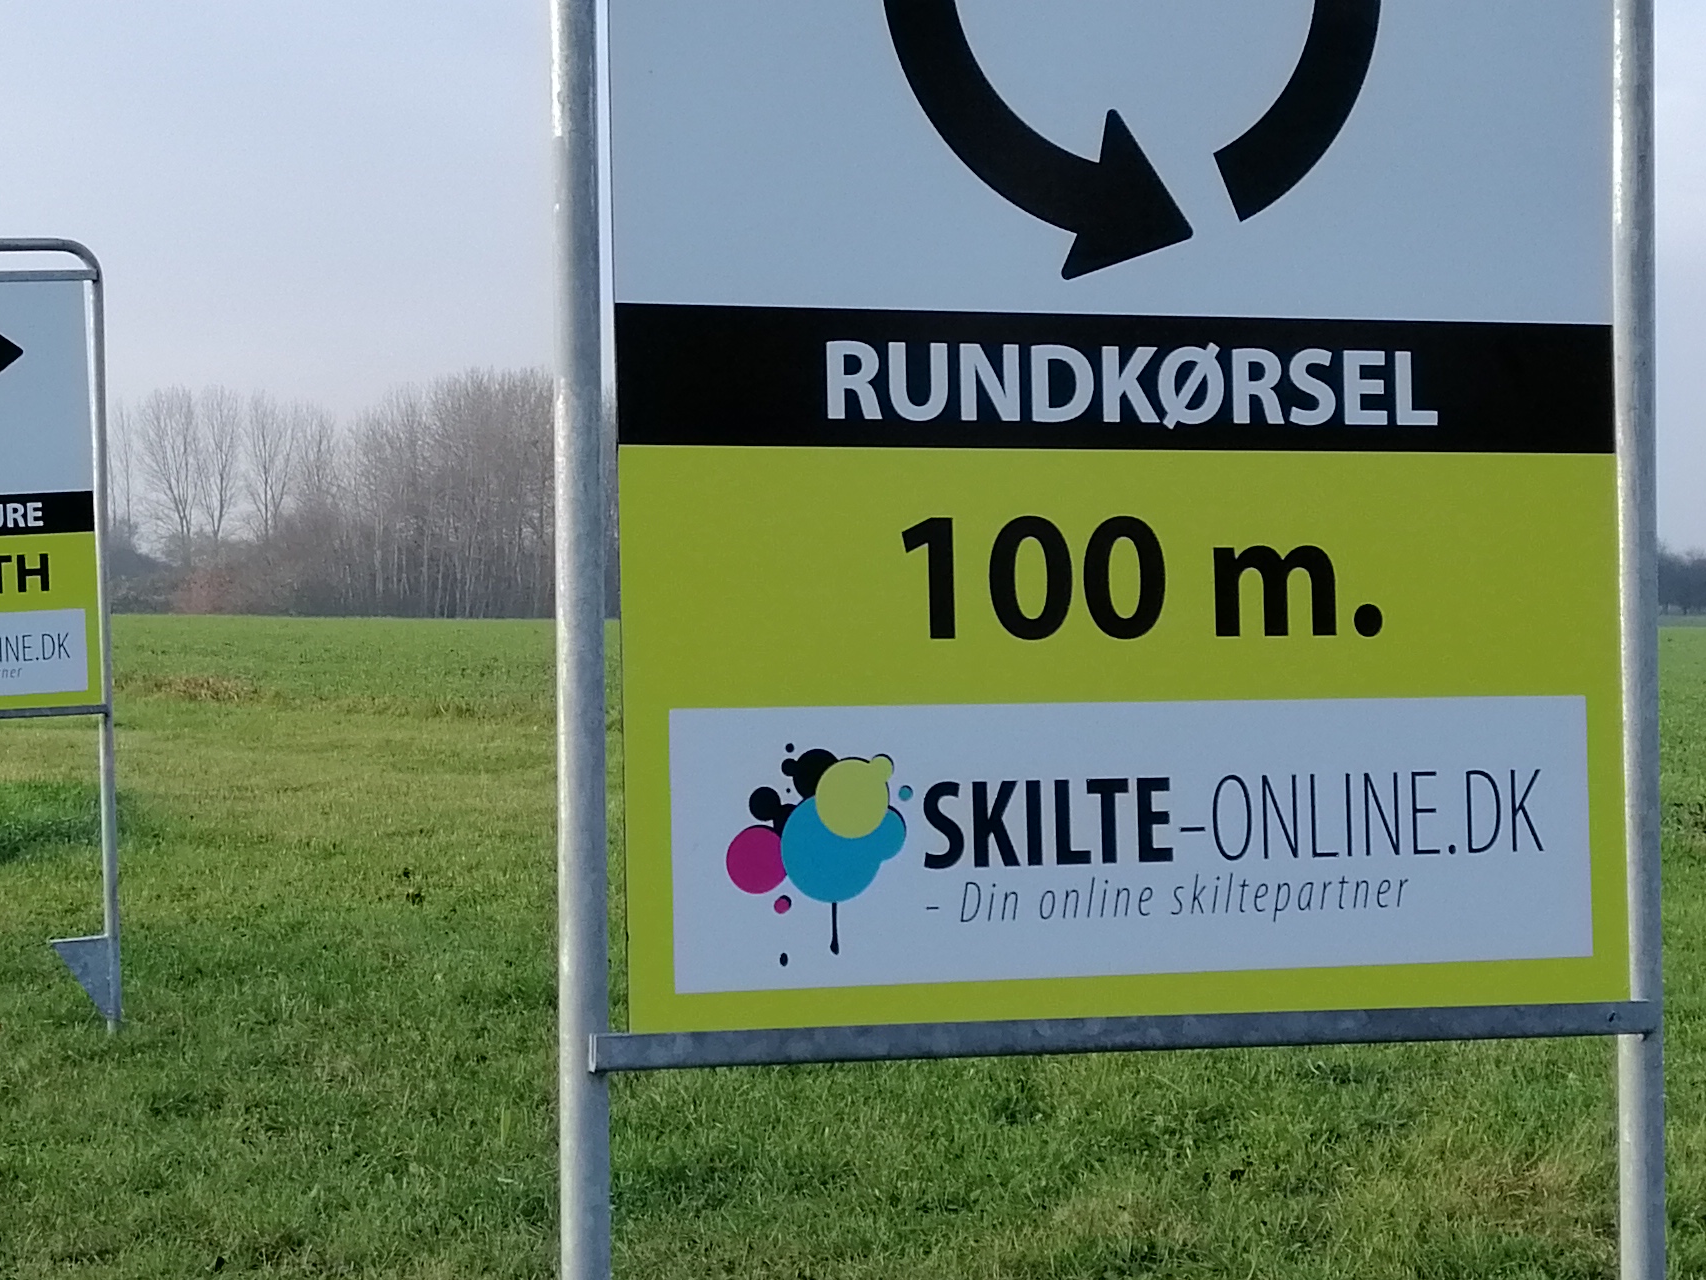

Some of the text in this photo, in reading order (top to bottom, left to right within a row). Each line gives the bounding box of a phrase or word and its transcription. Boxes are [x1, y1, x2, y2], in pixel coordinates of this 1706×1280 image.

[825, 338, 1439, 431] RUNDKØRSEL
[901, 515, 1383, 641] 100 m.
[922, 768, 1545, 869] SKILTE-ONLINE.DK
[958, 880, 1019, 923] Din
[1038, 875, 1155, 920] online
[1170, 871, 1411, 922] skiltepartner
